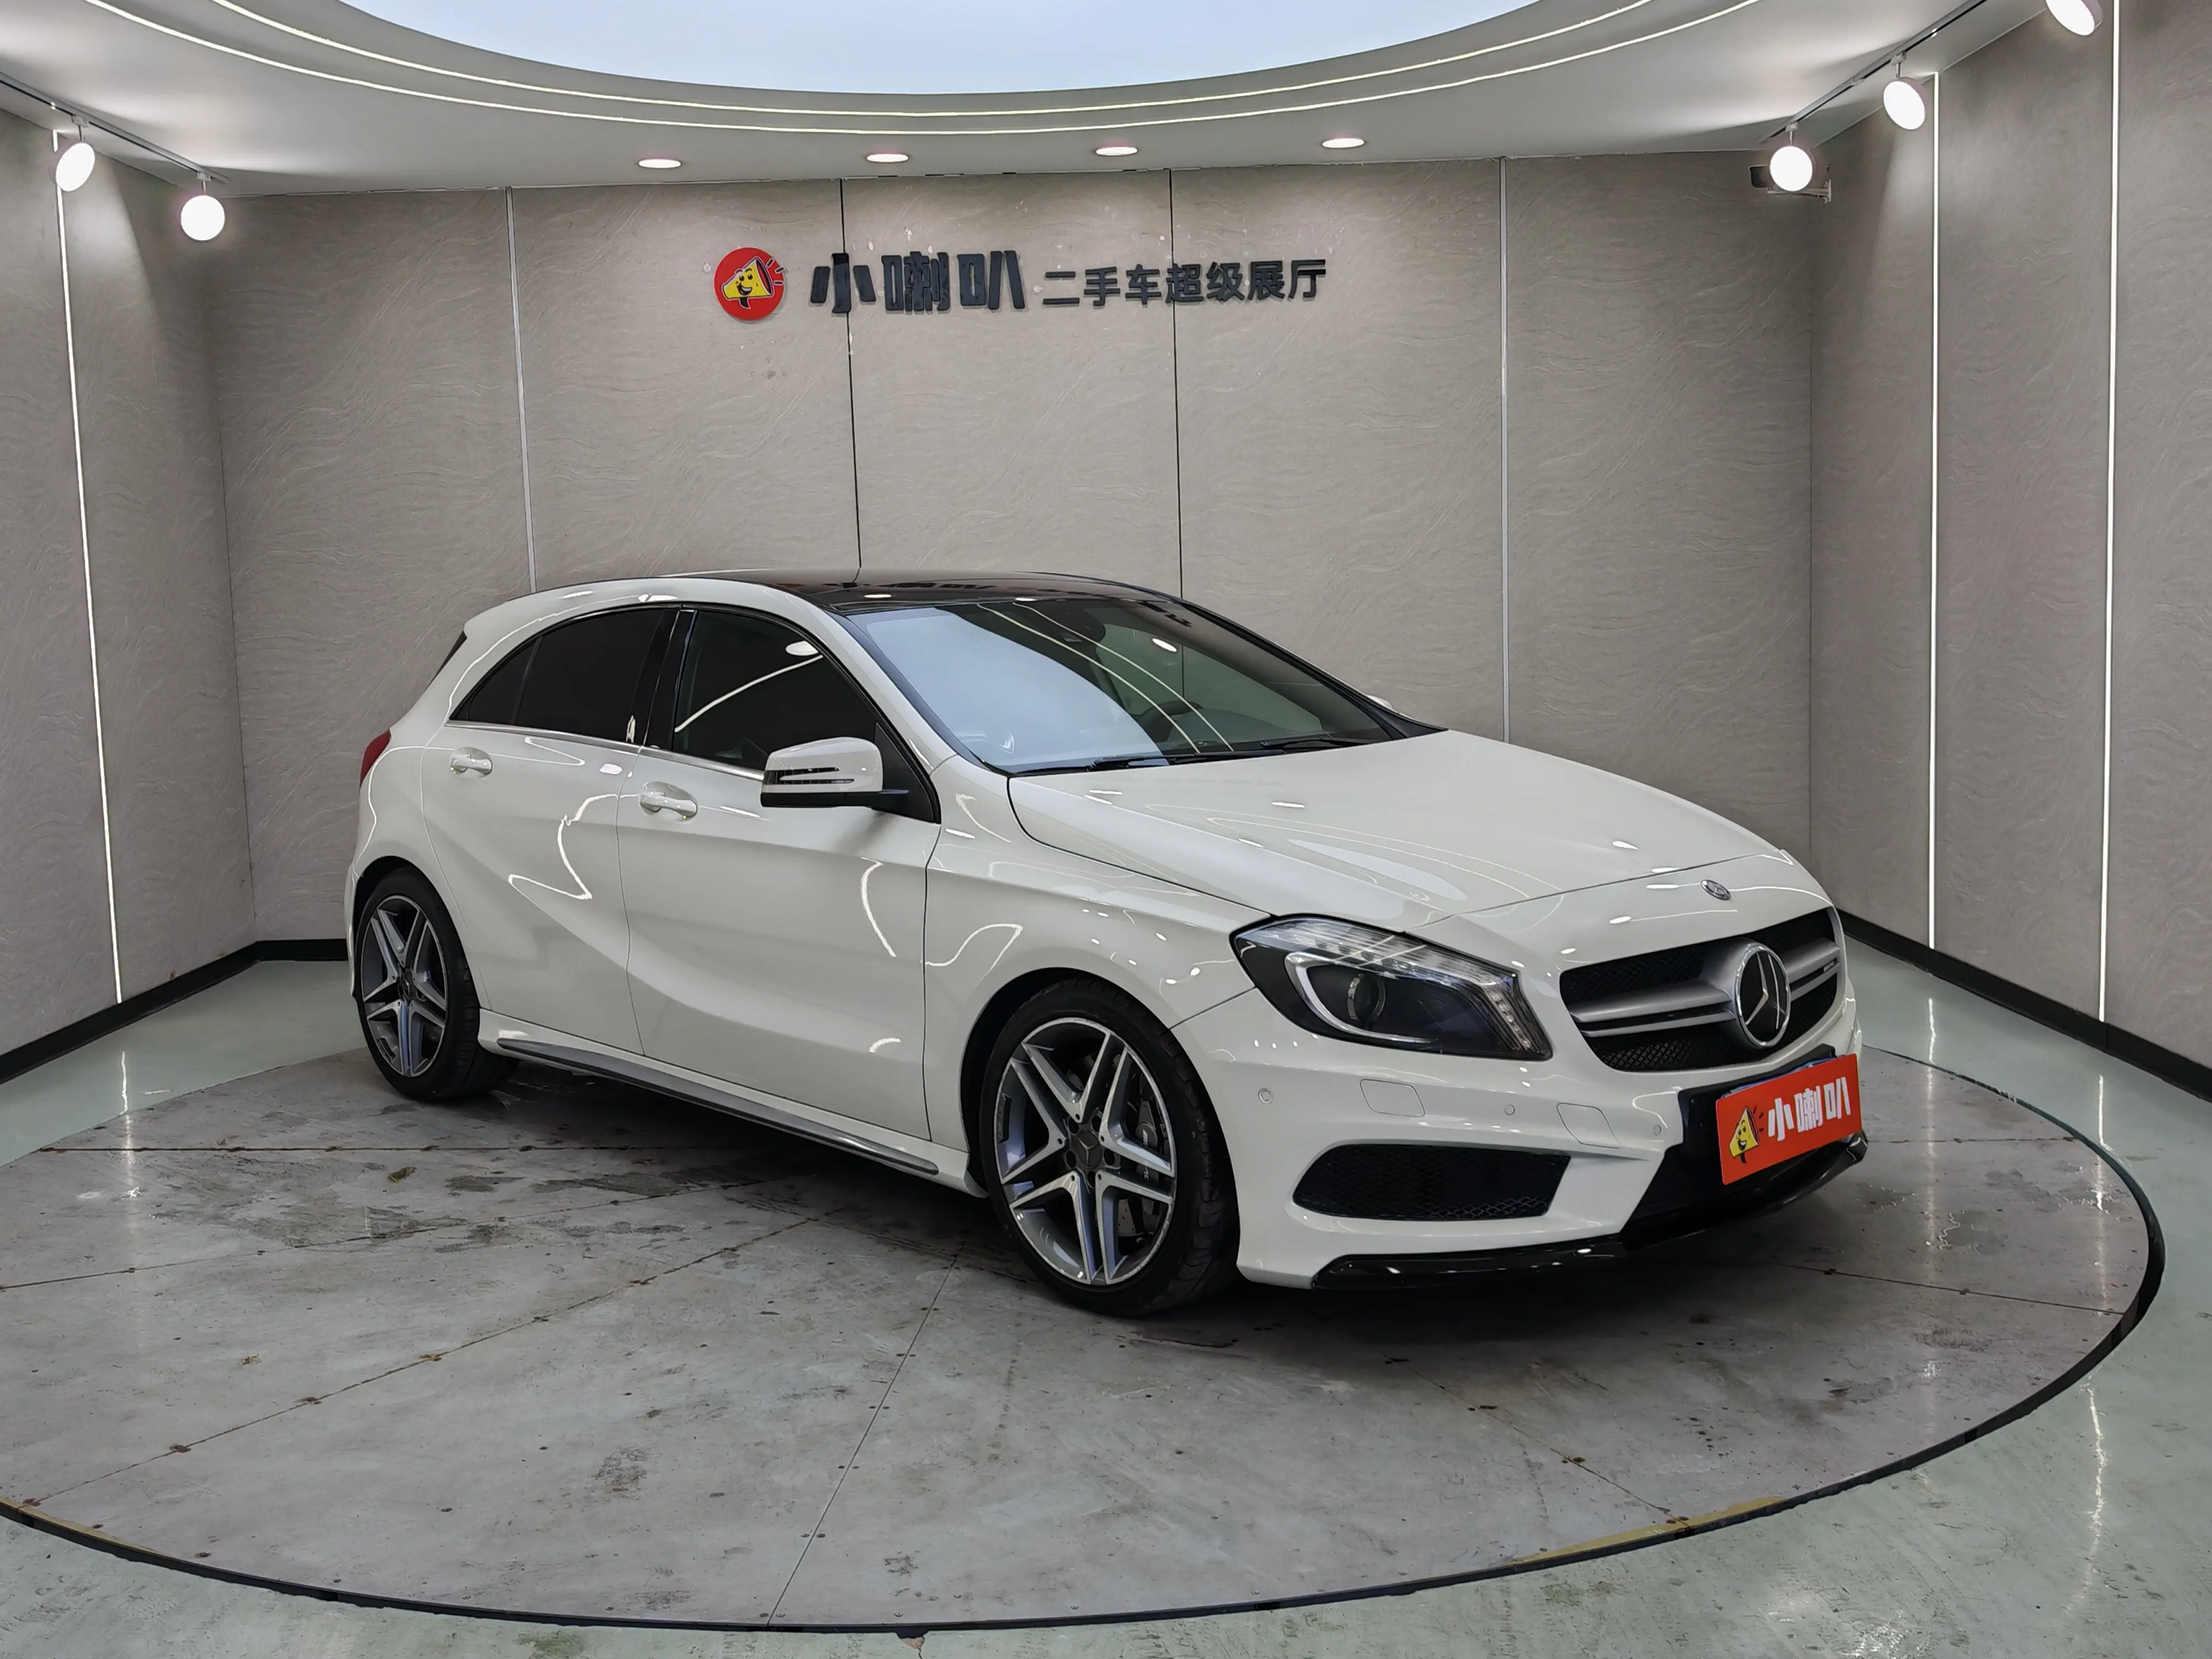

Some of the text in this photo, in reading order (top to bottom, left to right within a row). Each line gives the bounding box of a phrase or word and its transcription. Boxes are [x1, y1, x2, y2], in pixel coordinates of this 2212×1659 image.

[810, 251, 1326, 313] 小喇叭 二手车超级展厅
[1768, 1076, 1851, 1142] 小喇叭
